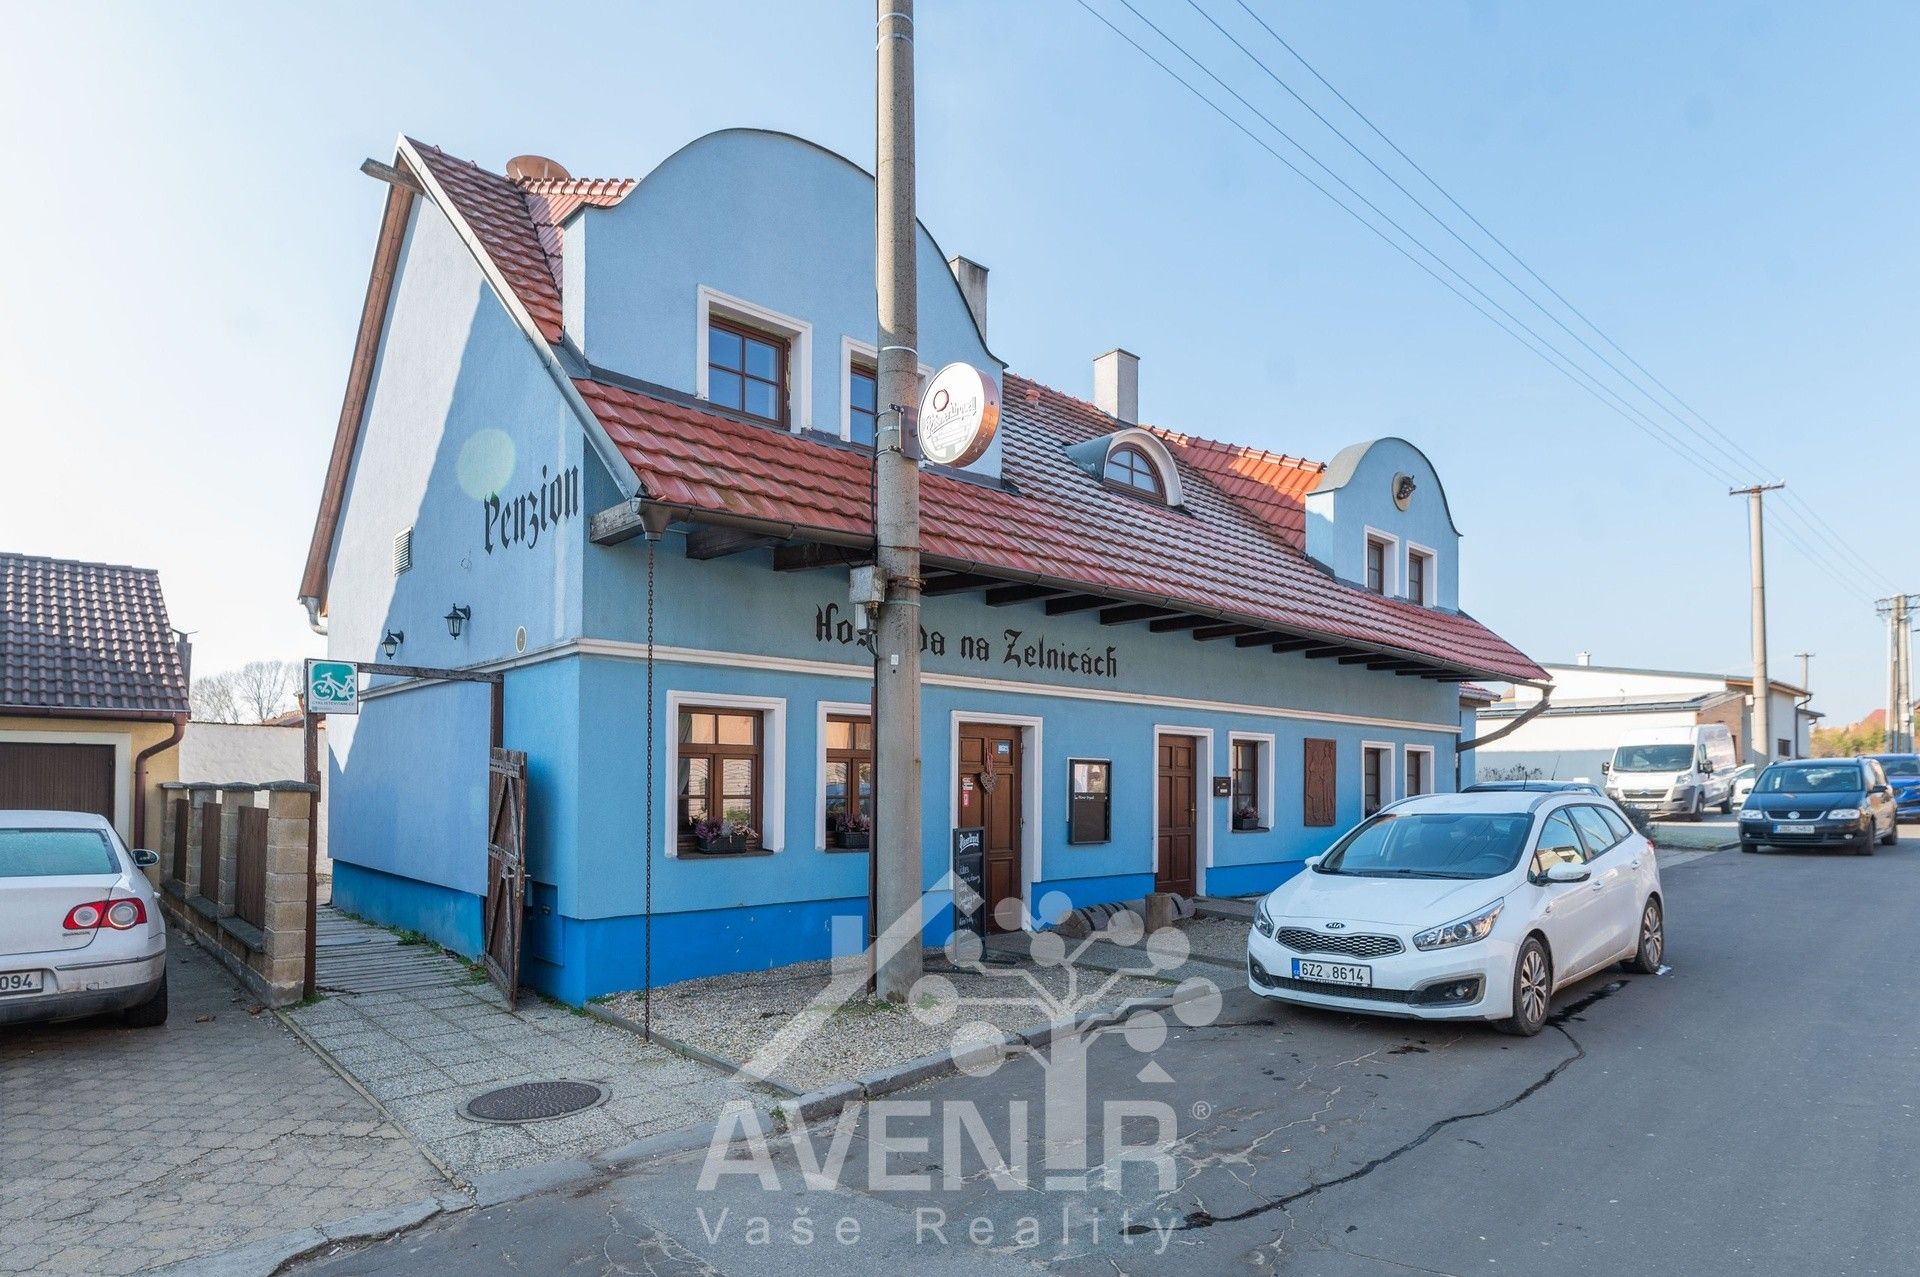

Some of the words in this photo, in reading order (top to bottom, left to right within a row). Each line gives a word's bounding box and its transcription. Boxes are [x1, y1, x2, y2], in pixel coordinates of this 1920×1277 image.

[483, 463, 579, 556] Penzion
[960, 635, 990, 662] na
[1002, 628, 1118, 679] Zelnicách
[1301, 962, 1323, 978] 6Z2
[1332, 966, 1364, 982] 8614
